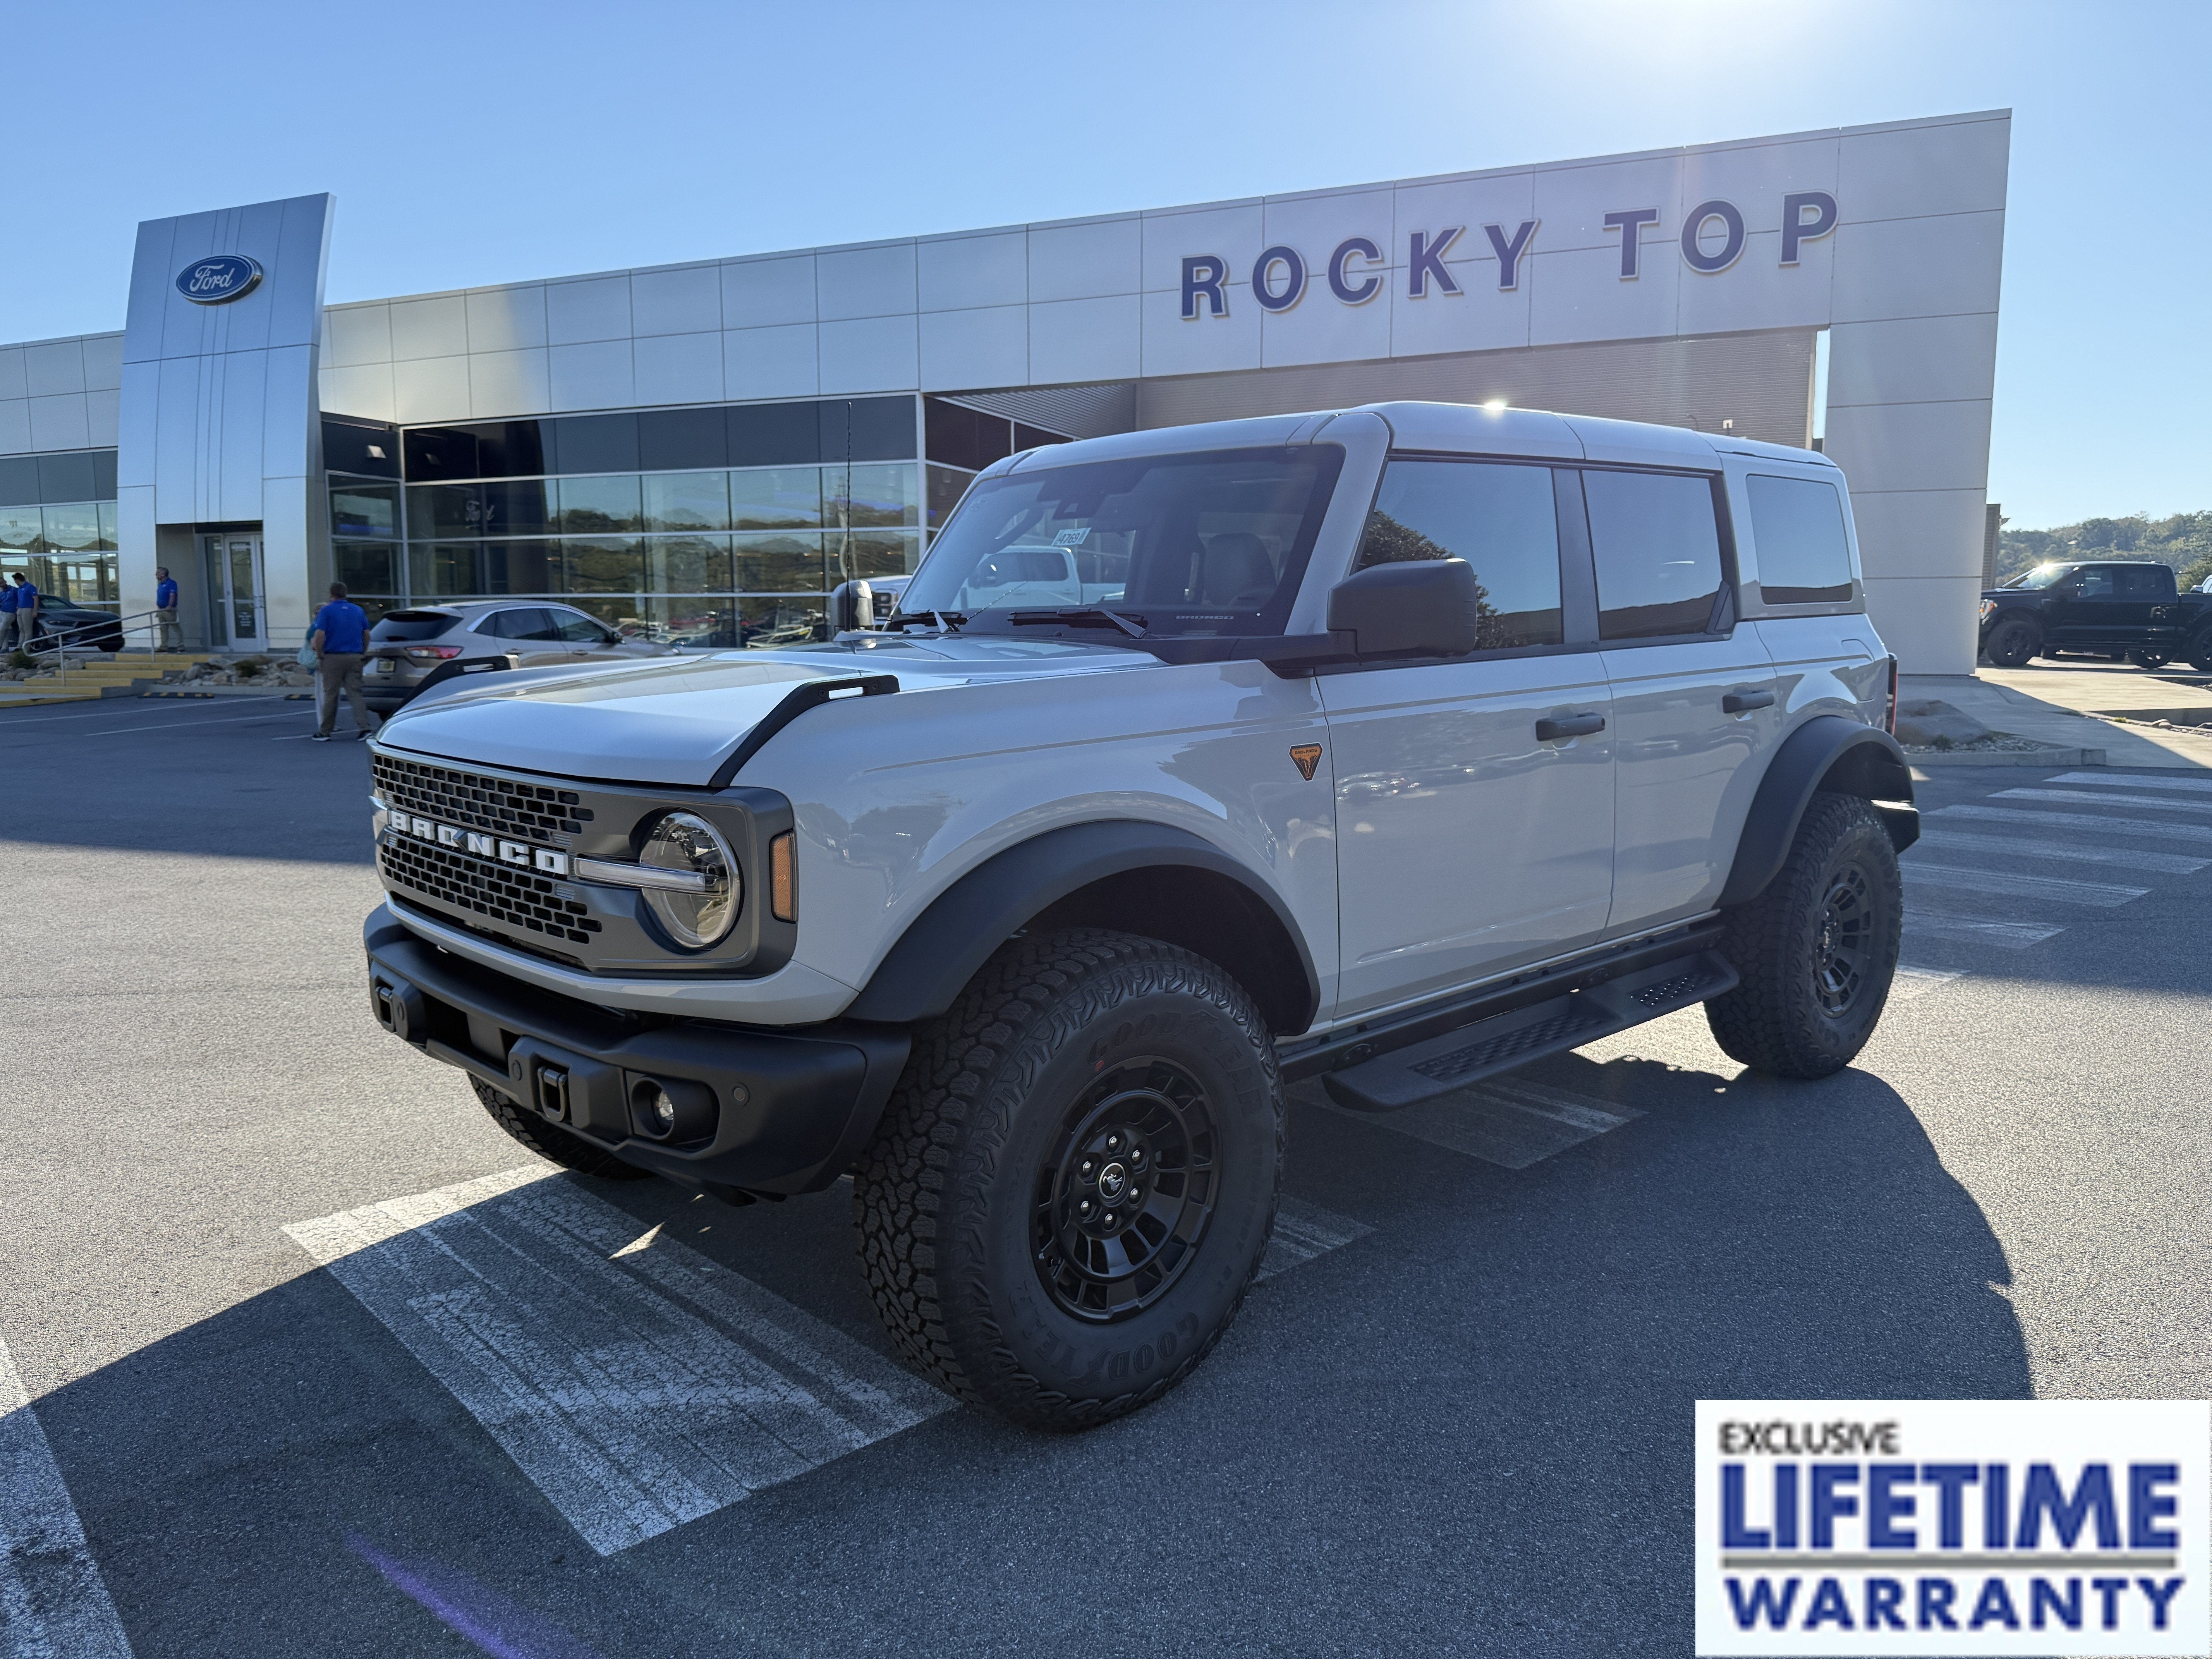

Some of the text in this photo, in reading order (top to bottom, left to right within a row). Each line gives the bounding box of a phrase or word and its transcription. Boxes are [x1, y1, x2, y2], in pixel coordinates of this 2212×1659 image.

[189, 264, 235, 292] Ford
[1180, 192, 1838, 318] ROCKY TOP
[1059, 532, 1080, 544] 4769
[390, 810, 568, 875] BRONCO
